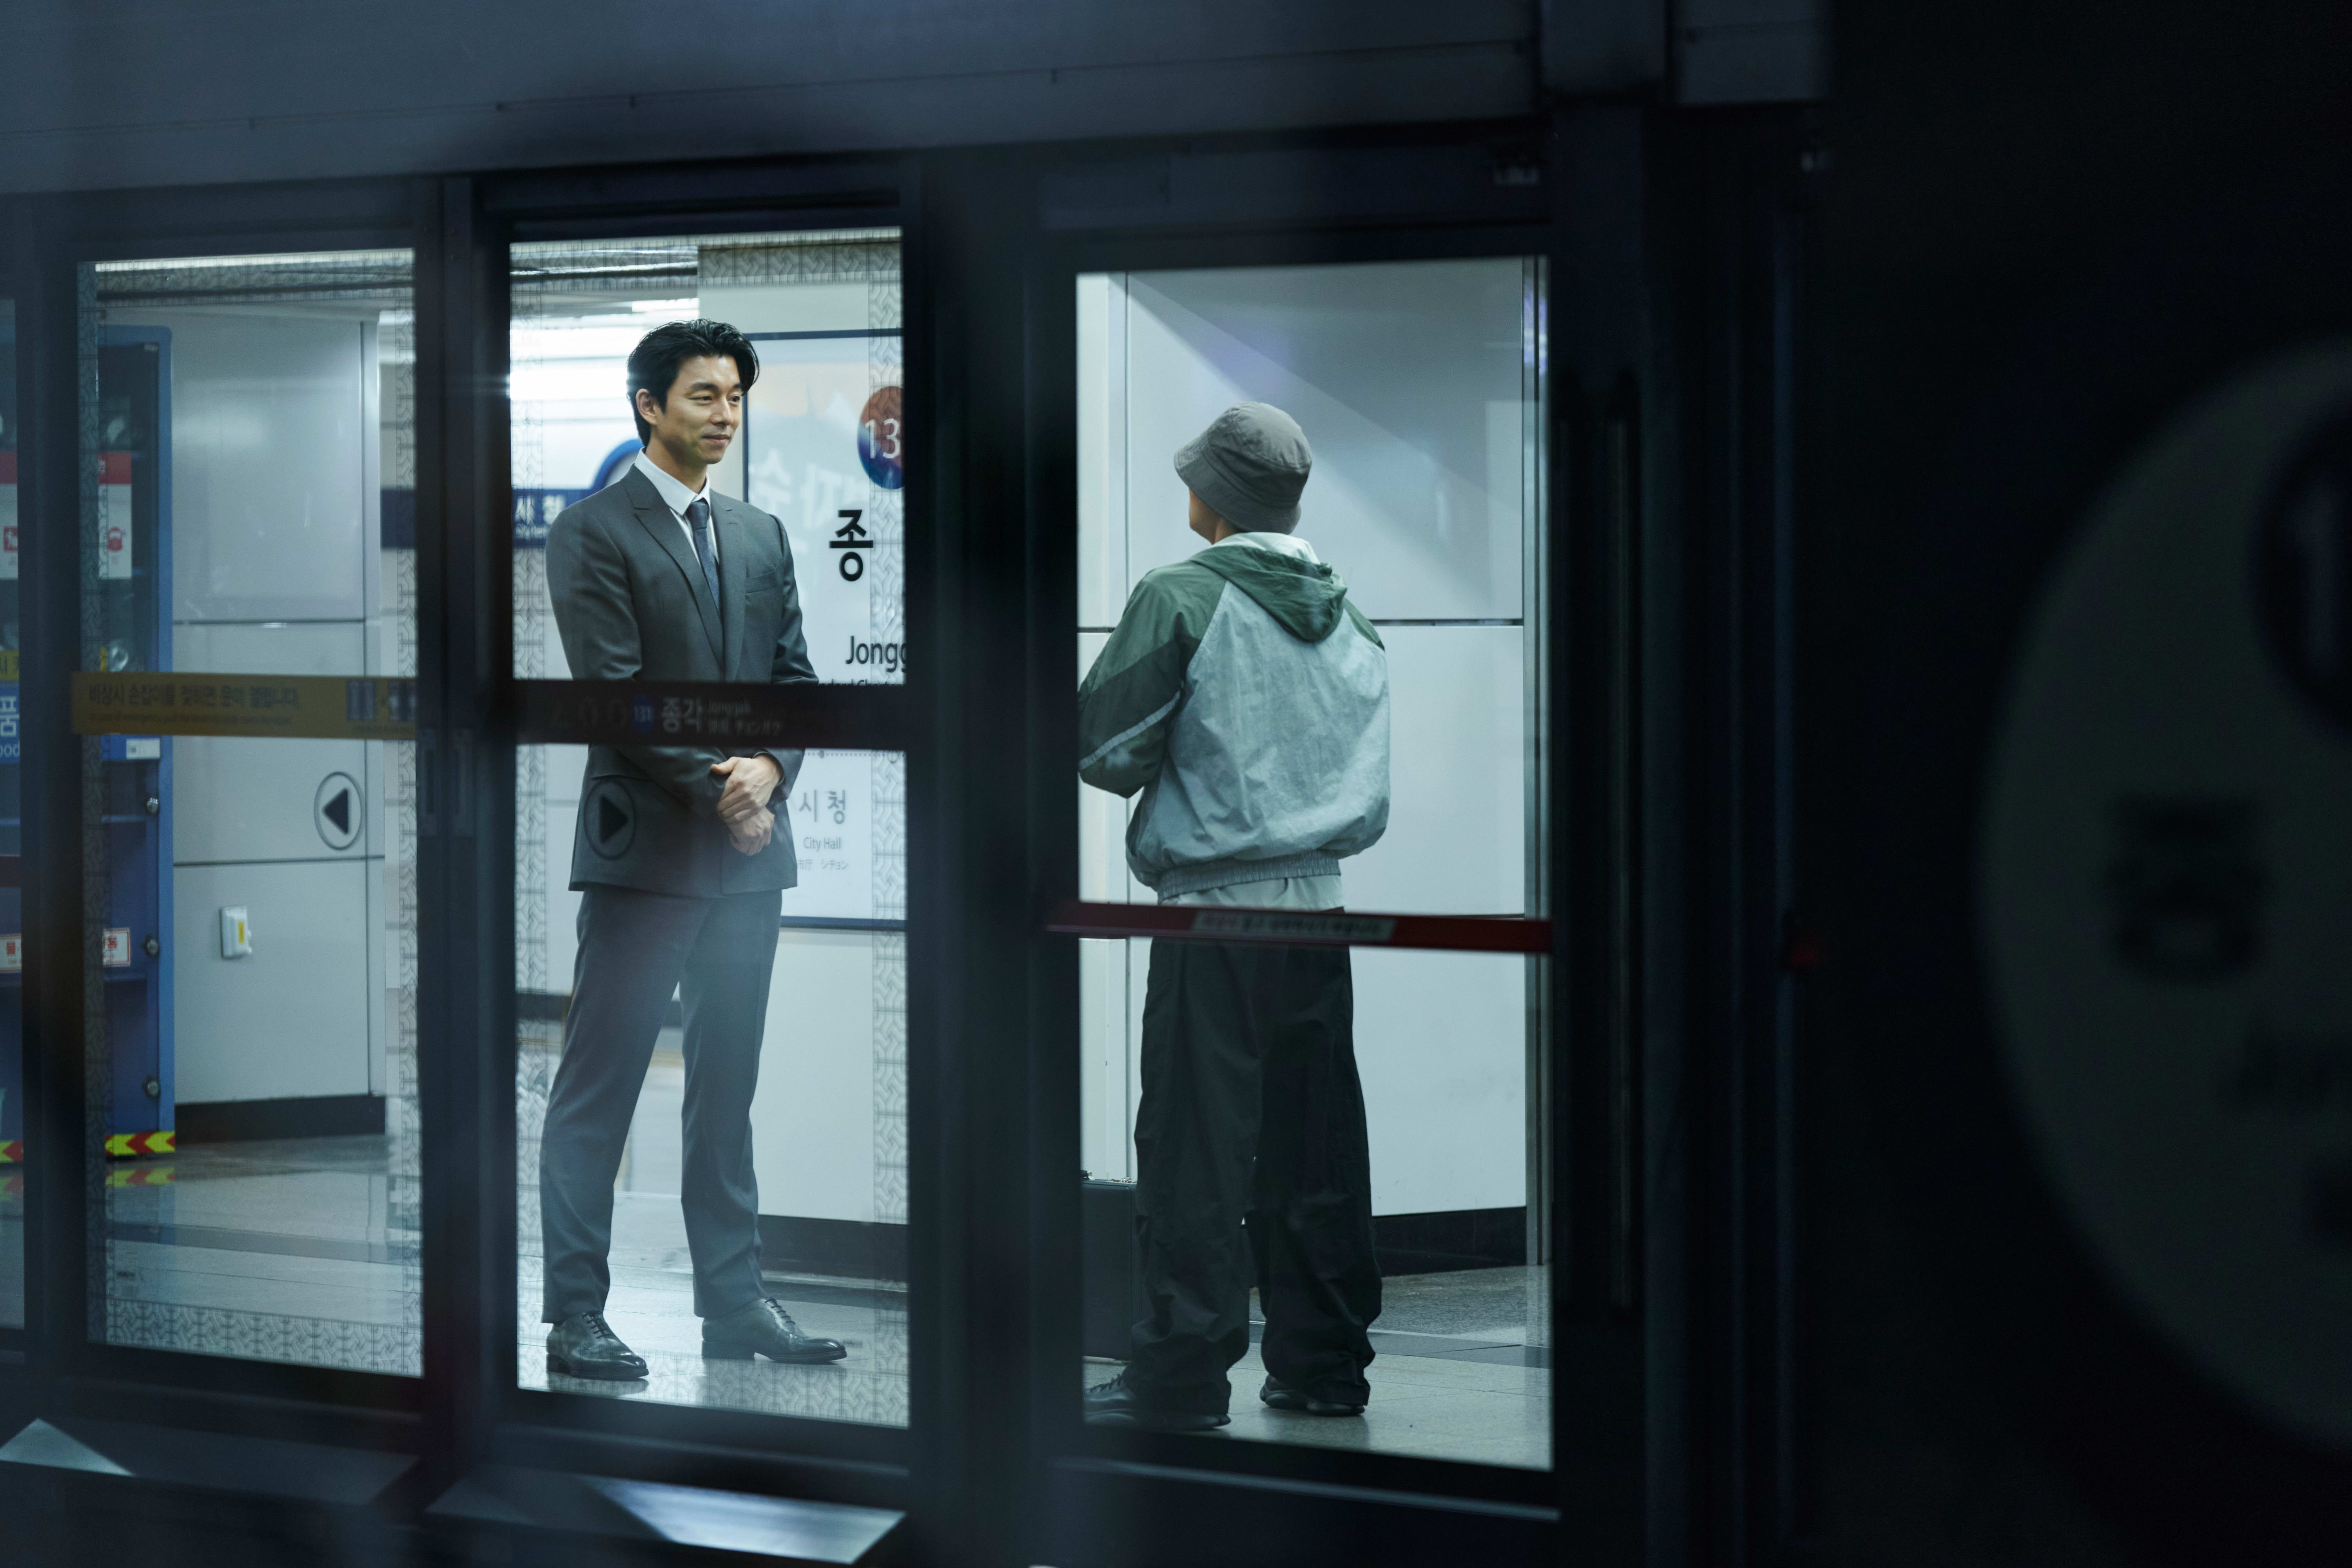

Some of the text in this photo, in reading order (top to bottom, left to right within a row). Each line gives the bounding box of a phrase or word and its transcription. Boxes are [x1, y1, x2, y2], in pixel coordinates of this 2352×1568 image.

[865, 418, 901, 459] 13
[828, 509, 874, 582] 종
[89, 683, 124, 706] 비상시
[661, 696, 702, 733] 종각
[799, 789, 846, 824] 시청
[803, 837, 841, 852] City Hall
